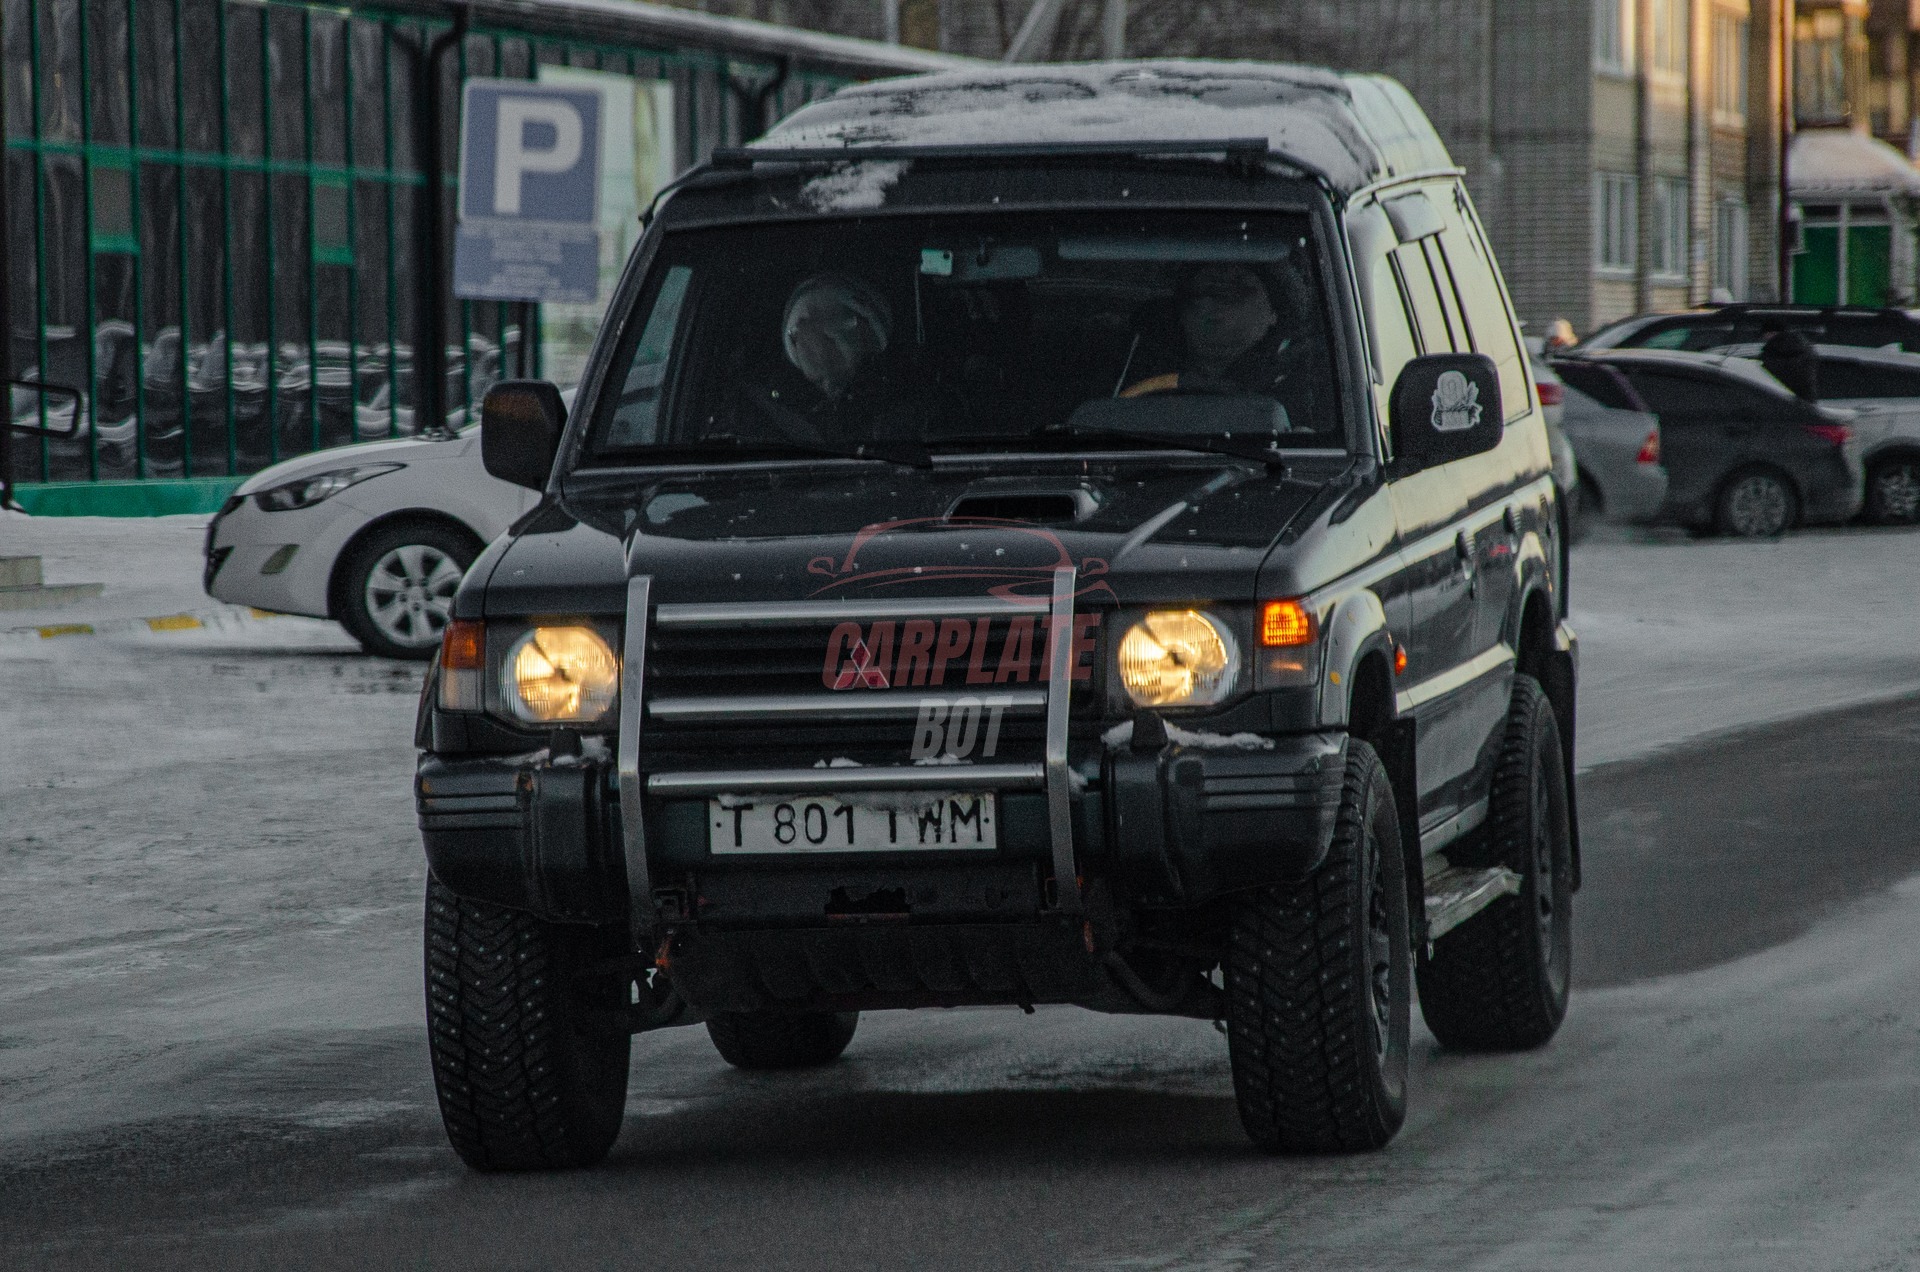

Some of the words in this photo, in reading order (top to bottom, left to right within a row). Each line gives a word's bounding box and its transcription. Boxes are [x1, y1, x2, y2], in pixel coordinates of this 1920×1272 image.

[494, 98, 583, 215] P
[721, 804, 753, 847] T
[775, 803, 854, 845] 801
